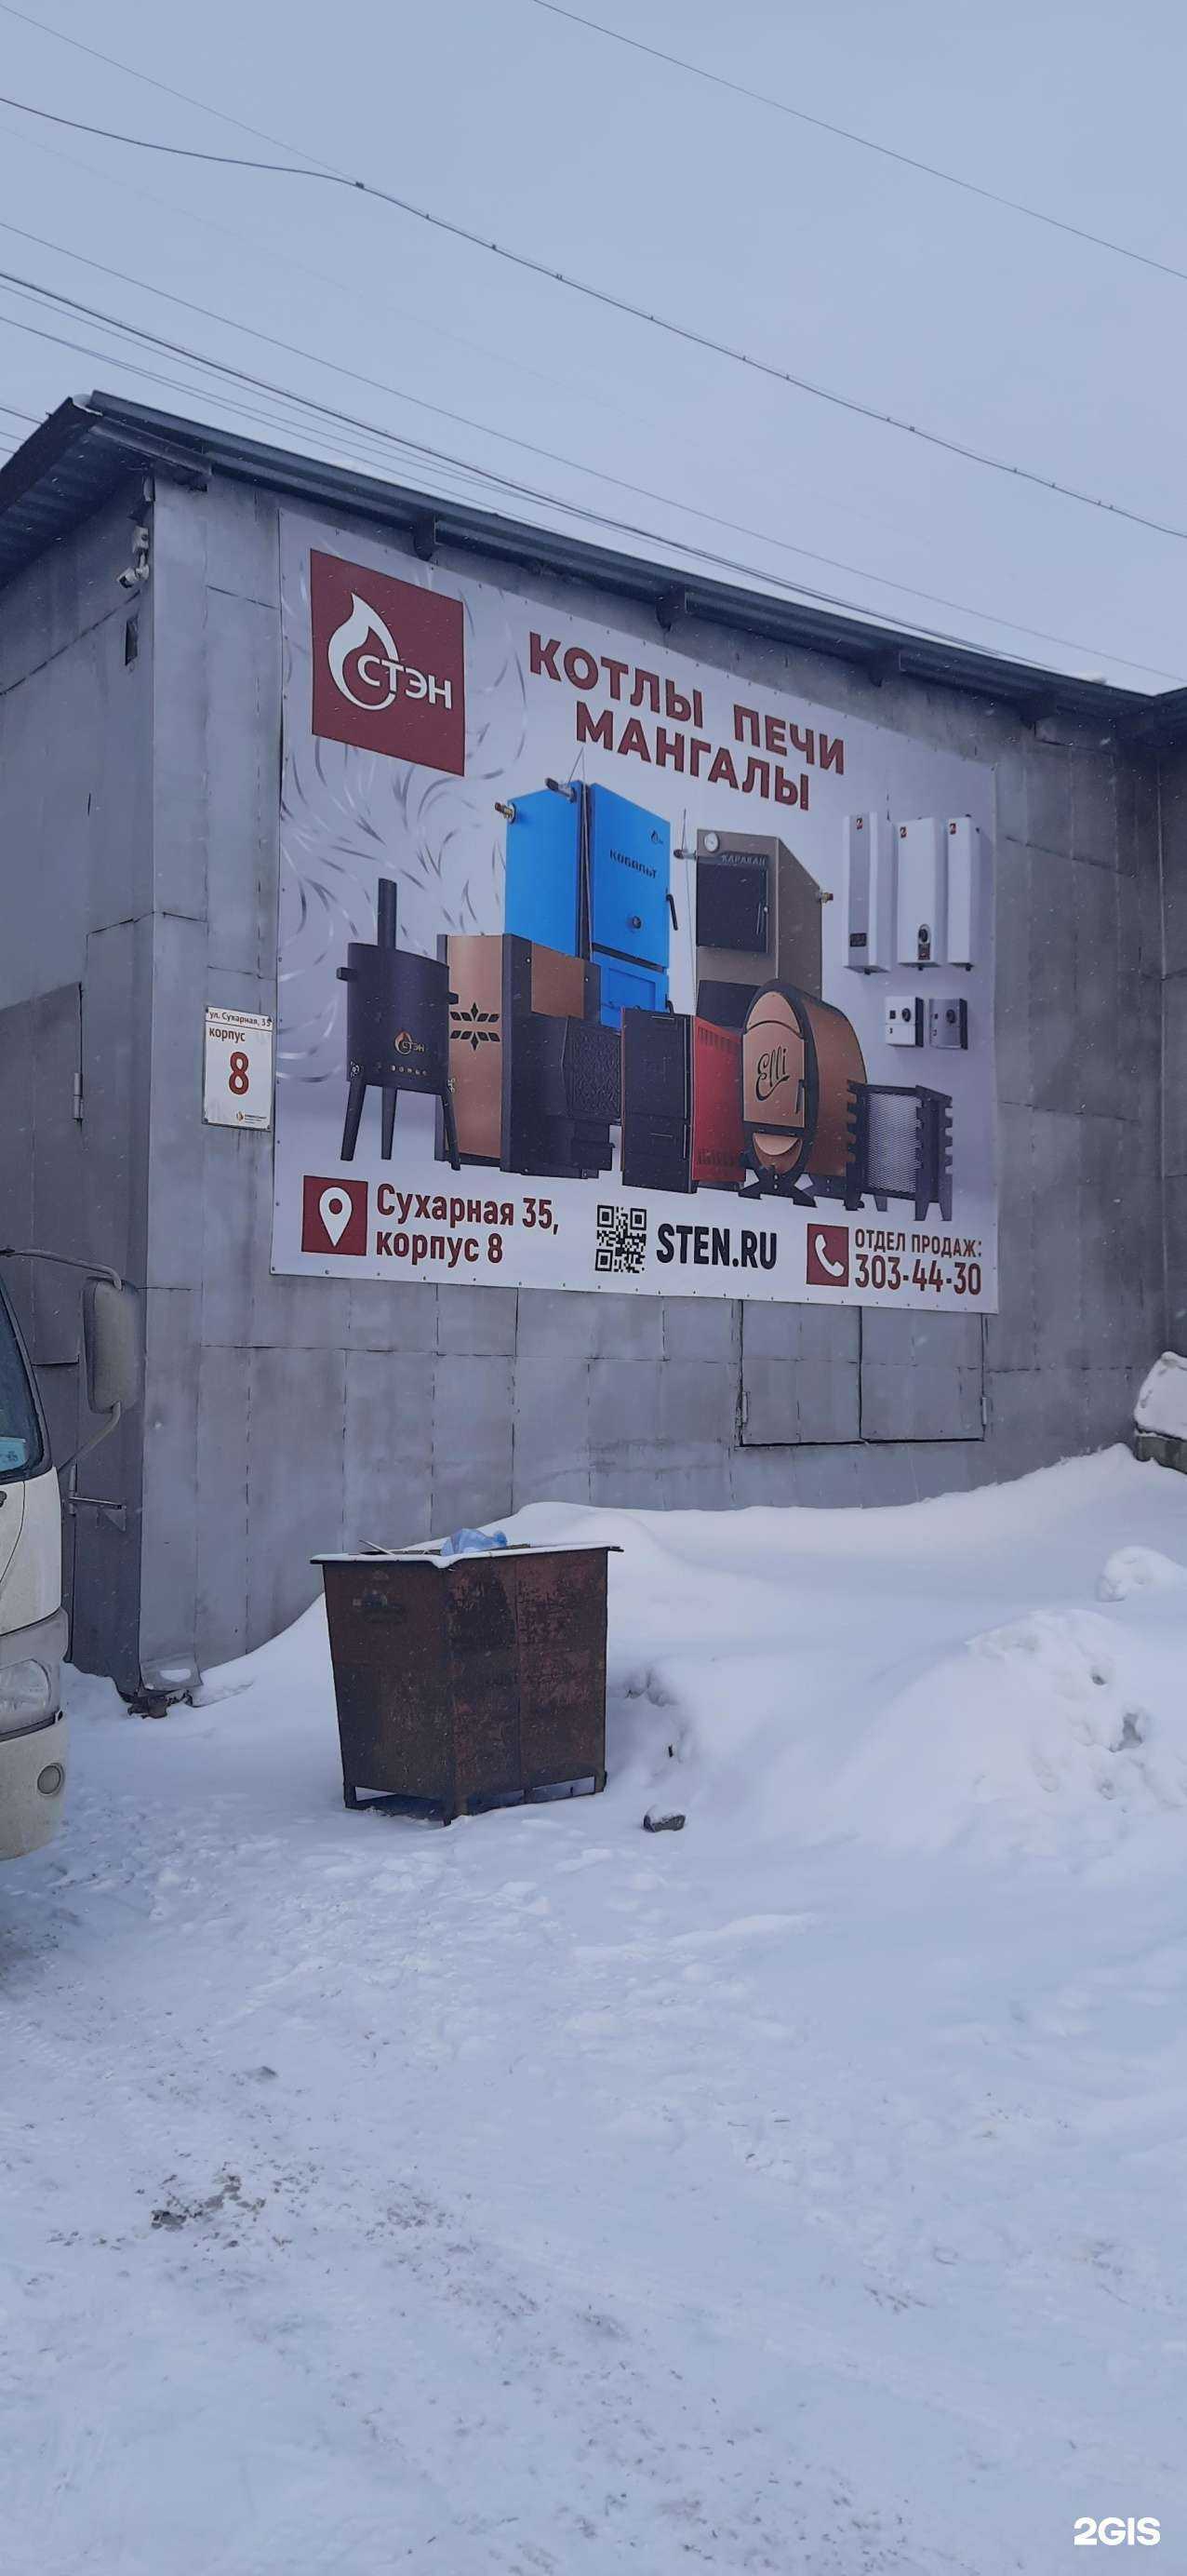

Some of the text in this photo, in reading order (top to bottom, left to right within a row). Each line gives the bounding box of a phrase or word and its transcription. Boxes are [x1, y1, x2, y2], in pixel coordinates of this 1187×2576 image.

[357, 654, 452, 710] СТЭН
[529, 631, 845, 775] КОТЛЫ ПЕЧИ
[576, 701, 808, 811] МАНГАЛЫ
[209, 1012, 220, 1020] ул.
[209, 1027, 246, 1043] корпус
[229, 1052, 249, 1094] 8
[755, 1046, 791, 1100] Elli
[377, 1183, 559, 1235] Сухарная 35,
[377, 1230, 503, 1268] корпус 8
[656, 1223, 778, 1269] STEN.RU
[855, 1228, 982, 1258] ОТДЕЛ ПРОДАЖ:
[855, 1254, 982, 1295] 303-44-30
